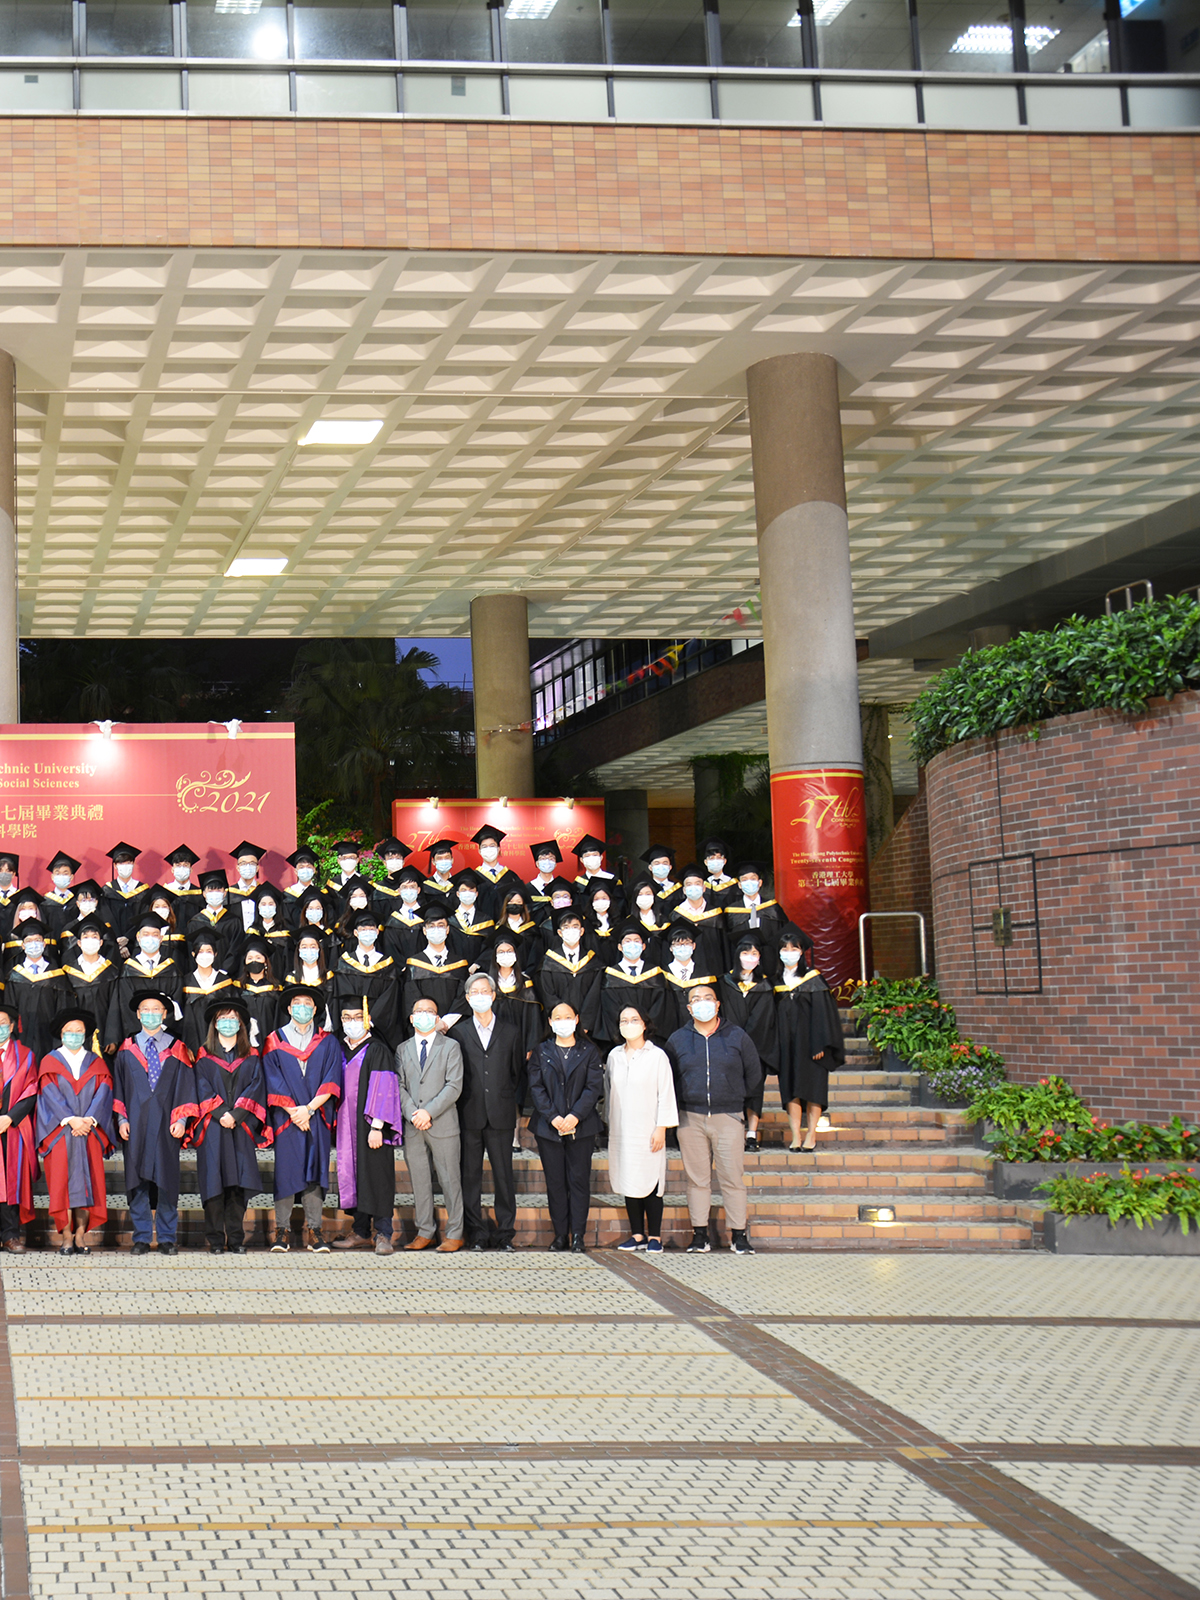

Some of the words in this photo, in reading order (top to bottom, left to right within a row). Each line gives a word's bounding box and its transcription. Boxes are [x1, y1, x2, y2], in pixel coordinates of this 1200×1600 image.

[34, 763, 97, 777] University
[33, 778, 80, 788] Sciences
[199, 791, 271, 813] 2021
